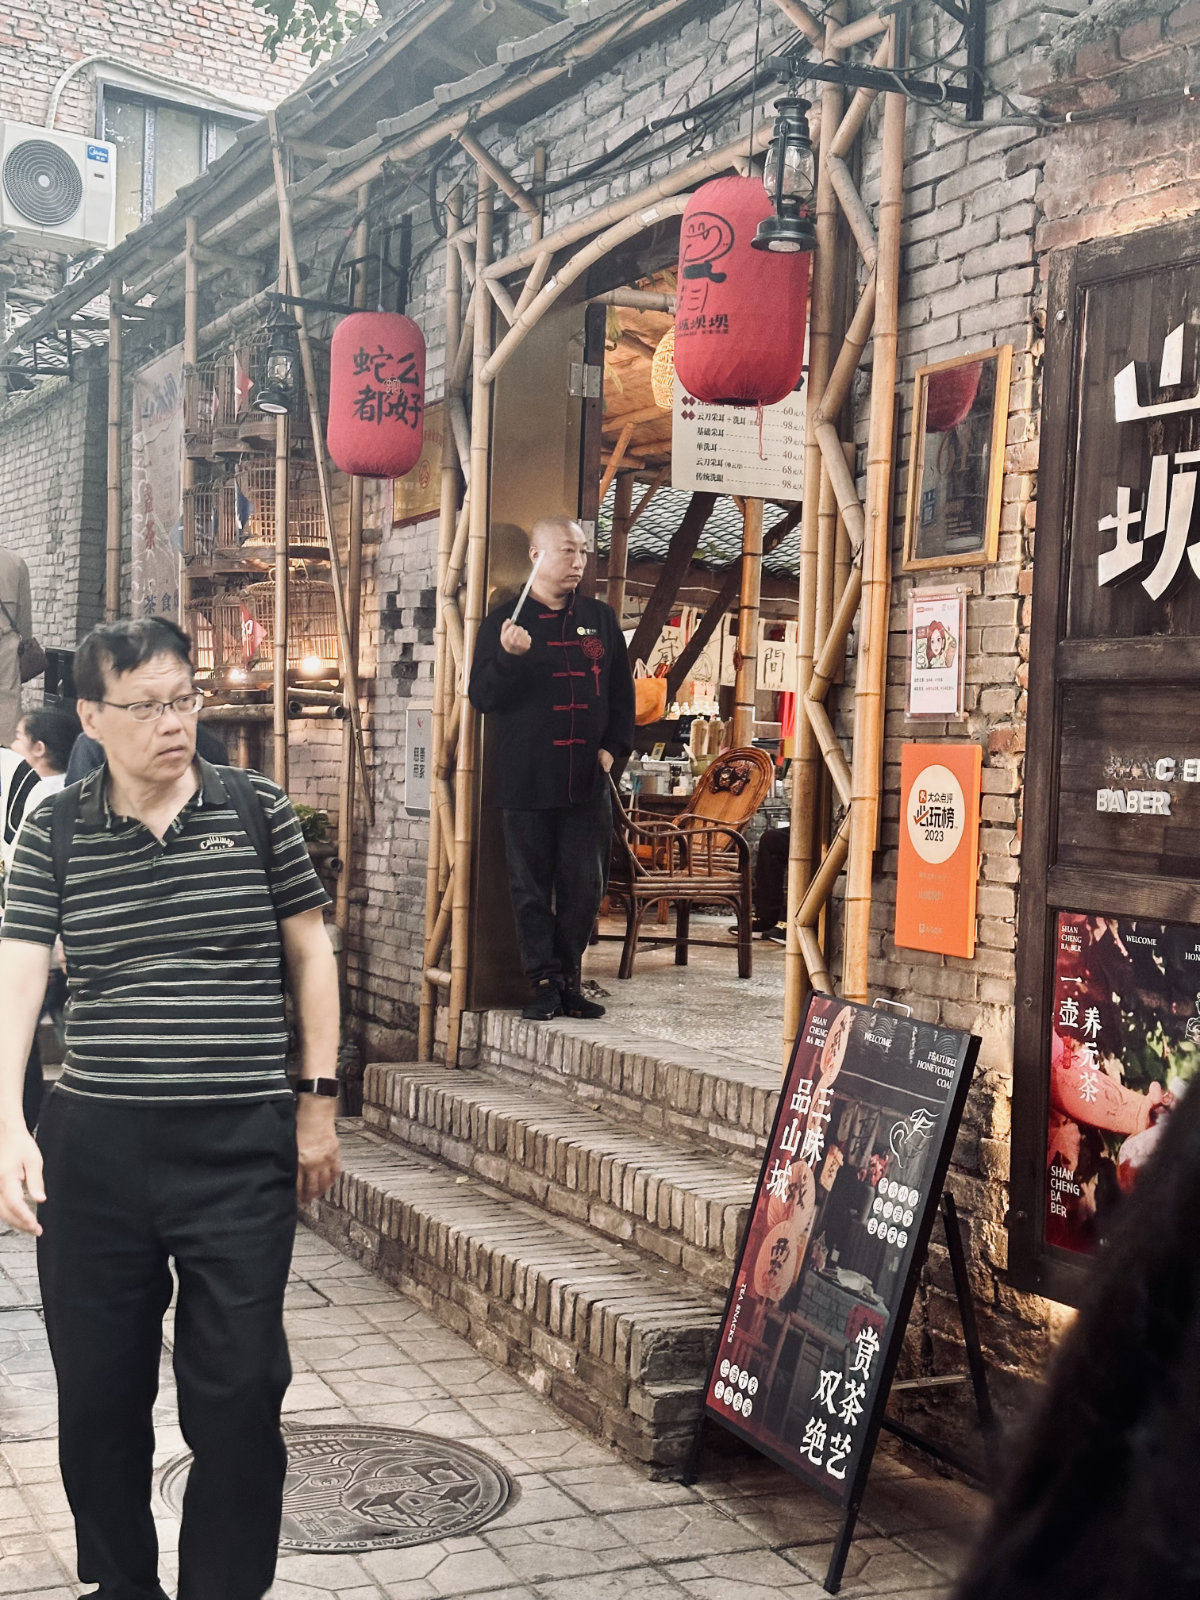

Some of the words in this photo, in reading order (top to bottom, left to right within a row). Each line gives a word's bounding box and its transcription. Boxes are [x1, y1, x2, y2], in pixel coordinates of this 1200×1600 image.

[927, 792, 954, 804] 大众点评
[913, 804, 955, 830] 必玩榜
[924, 829, 945, 842] 2023
[1060, 933, 1082, 944] CHENG
[1061, 925, 1079, 934] SHAN
[1125, 934, 1158, 946] WELCOME
[1059, 975, 1082, 1029] 一壶
[811, 1015, 828, 1027] SHAN
[809, 1025, 828, 1038] CHENG
[863, 1031, 893, 1048] WELCOME
[1079, 1005, 1103, 1103] 养元茶
[799, 1086, 834, 1168] 三味
[766, 1078, 813, 1204] 品山城
[1050, 1165, 1074, 1181] SHAN
[1050, 1178, 1081, 1196] CHENG
[1050, 1189, 1062, 1204] BA
[1050, 1201, 1068, 1219] BER
[737, 1283, 748, 1301] TEA
[726, 1305, 746, 1344] SNACKS
[825, 1325, 880, 1480] 赏茶艺
[799, 1369, 843, 1466] 双绝
